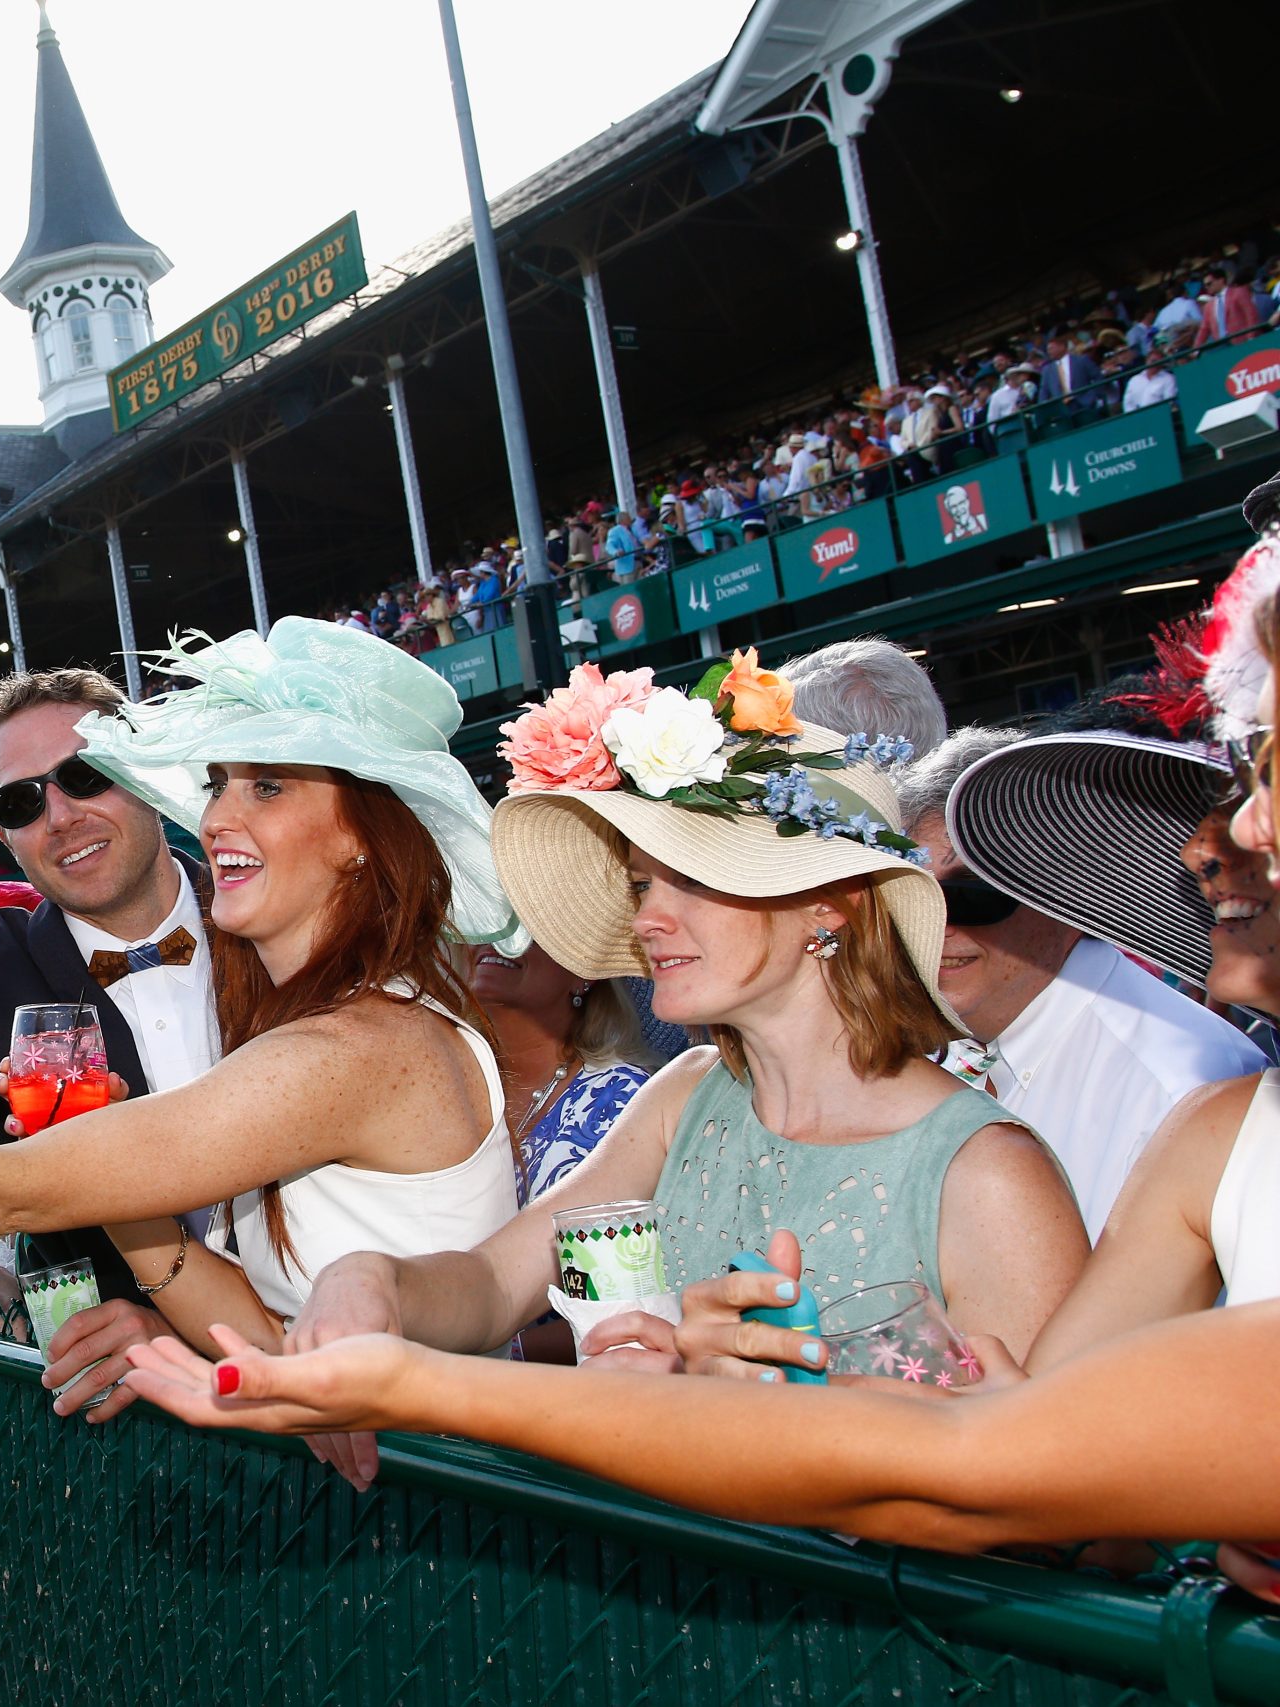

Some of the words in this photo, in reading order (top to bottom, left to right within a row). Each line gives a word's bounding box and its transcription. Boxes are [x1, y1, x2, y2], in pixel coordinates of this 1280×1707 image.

[285, 235, 346, 287] DERBY
[255, 268, 334, 337] 2016
[117, 359, 155, 396] FIRST
[158, 327, 204, 369] DERBY
[128, 351, 198, 416] 1875
[812, 532, 854, 563] Yum!
